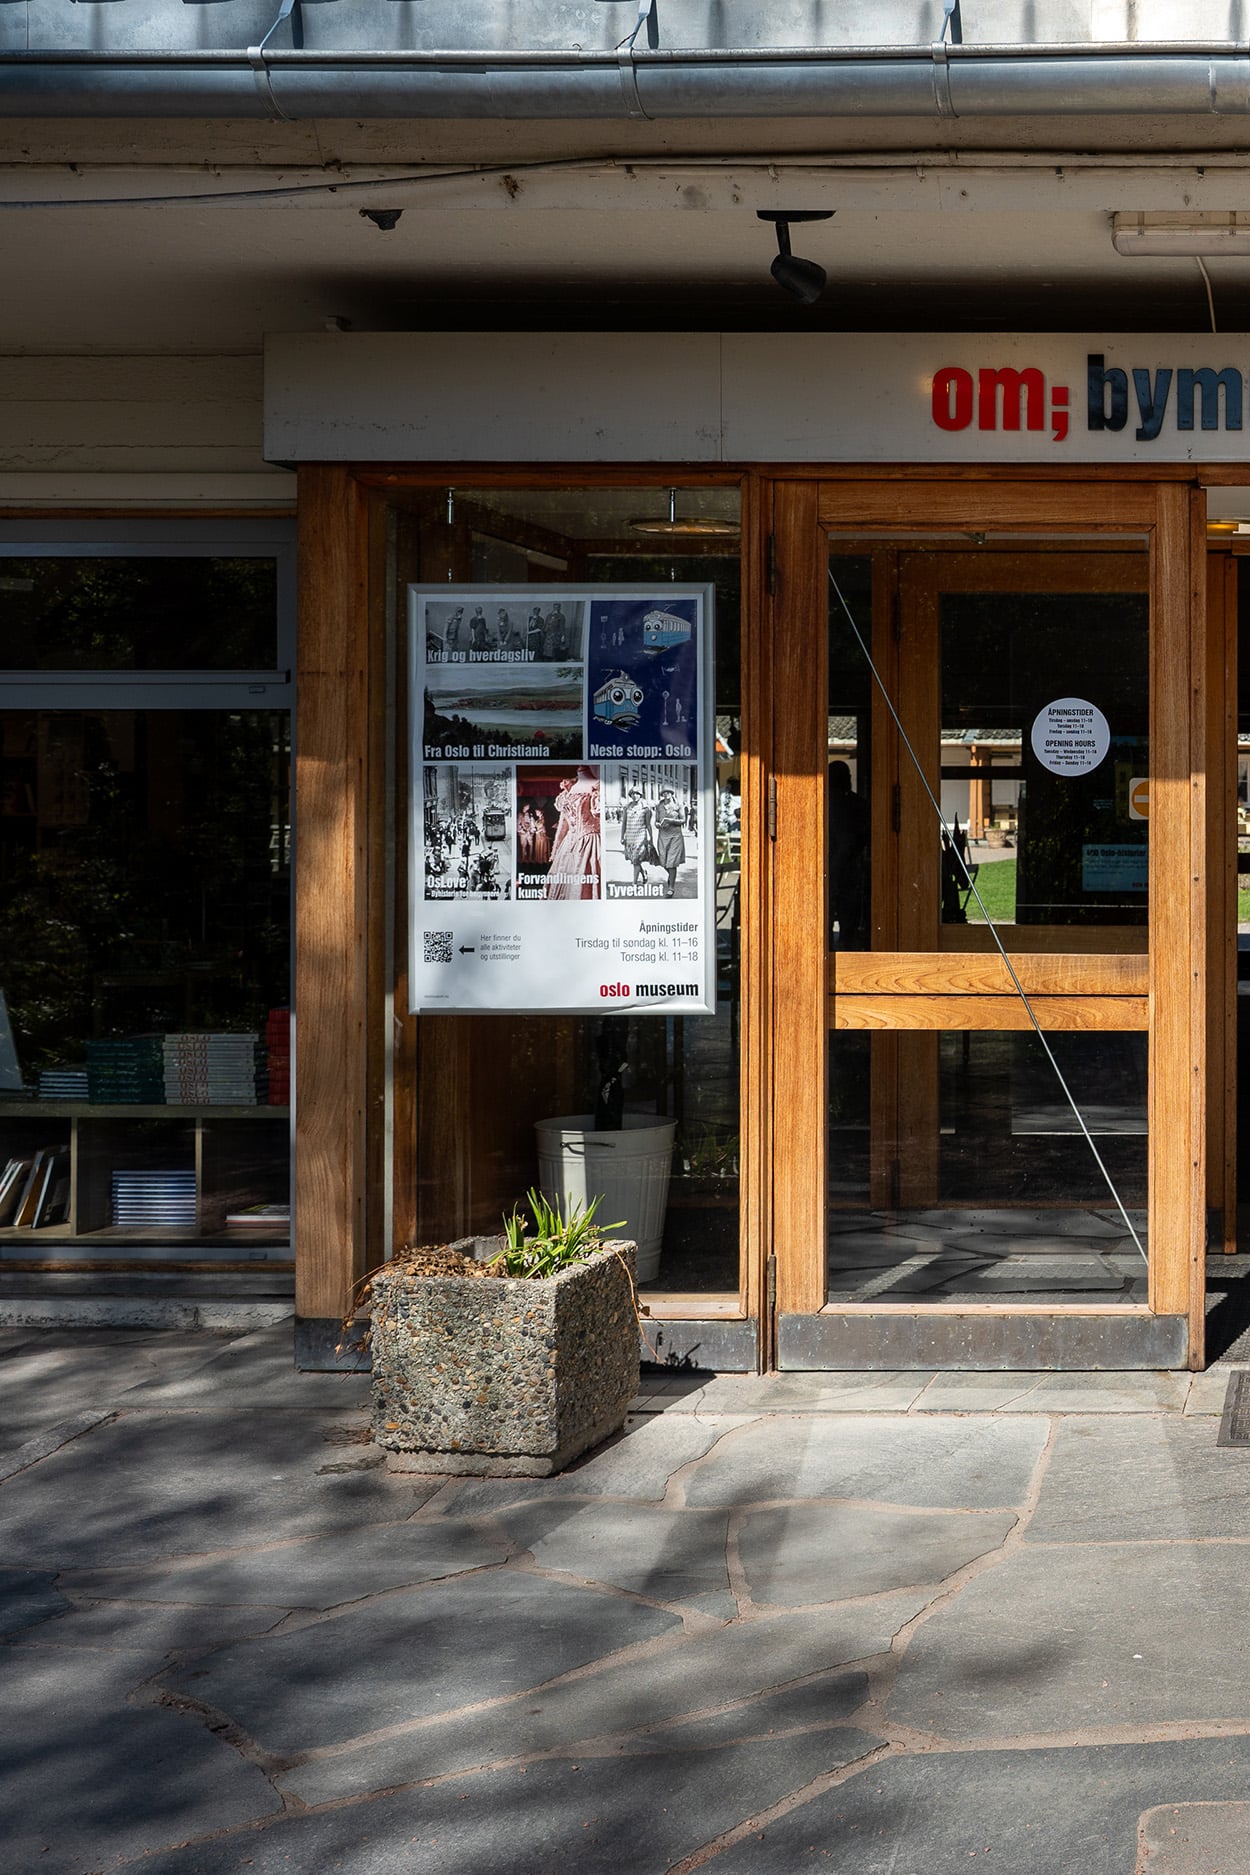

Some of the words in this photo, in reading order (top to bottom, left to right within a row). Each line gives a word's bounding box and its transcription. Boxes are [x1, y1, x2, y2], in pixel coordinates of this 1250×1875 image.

[932, 367, 1069, 442] om;
[427, 649, 448, 663] Krig
[452, 652, 466, 663] og
[469, 649, 535, 663] hverdagsliv
[1048, 707, 1094, 716] ÅPNINGSTIDER
[424, 745, 442, 758] Fra
[445, 745, 470, 758] Oslo
[473, 744, 486, 758] til
[489, 744, 550, 758] Christiania
[590, 744, 625, 757] Neste
[628, 745, 662, 759] stopp:
[666, 744, 692, 757] Oslo
[427, 875, 467, 889] OsLove
[518, 873, 600, 886] Forvandlingens
[518, 887, 548, 899] kunst
[608, 883, 664, 897] Tyvetallet
[639, 920, 698, 936] Åpningstider
[493, 934, 510, 942] finner
[512, 934, 522, 942] du
[576, 938, 610, 950] Tirsdag
[612, 938, 620, 948] til
[623, 937, 656, 950] søndag
[658, 937, 669, 948] kl.
[489, 952, 520, 962] utstillinger
[620, 952, 656, 964] Torsdag
[658, 951, 669, 962] kl.
[600, 982, 630, 997] oslo
[636, 983, 698, 997] museum
